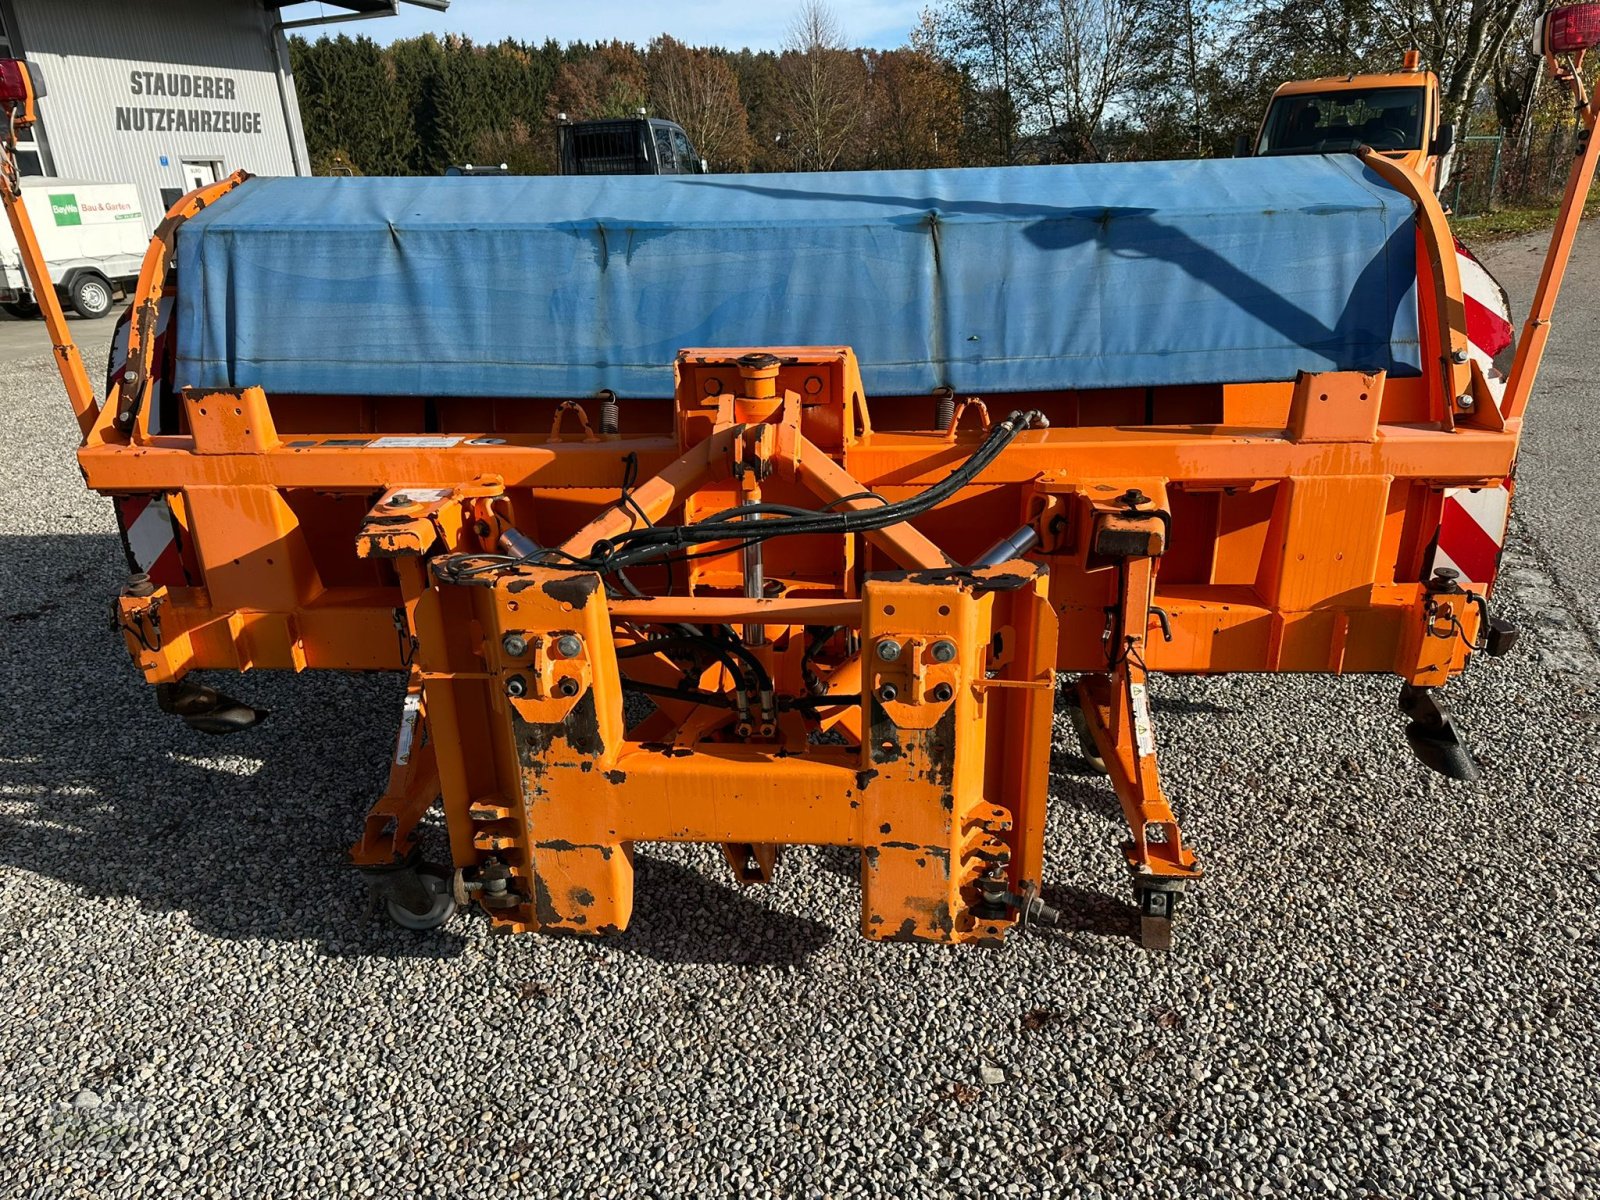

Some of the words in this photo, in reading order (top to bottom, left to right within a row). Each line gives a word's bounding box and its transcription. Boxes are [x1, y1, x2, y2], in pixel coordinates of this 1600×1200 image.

[130, 70, 235, 100] STAUDERER
[115, 106, 262, 134] NUTZFAHRZEUGE
[52, 204, 78, 215] BayWa
[81, 204, 97, 212] Bau
[98, 203, 105, 211] &
[105, 202, 131, 211] Garten
